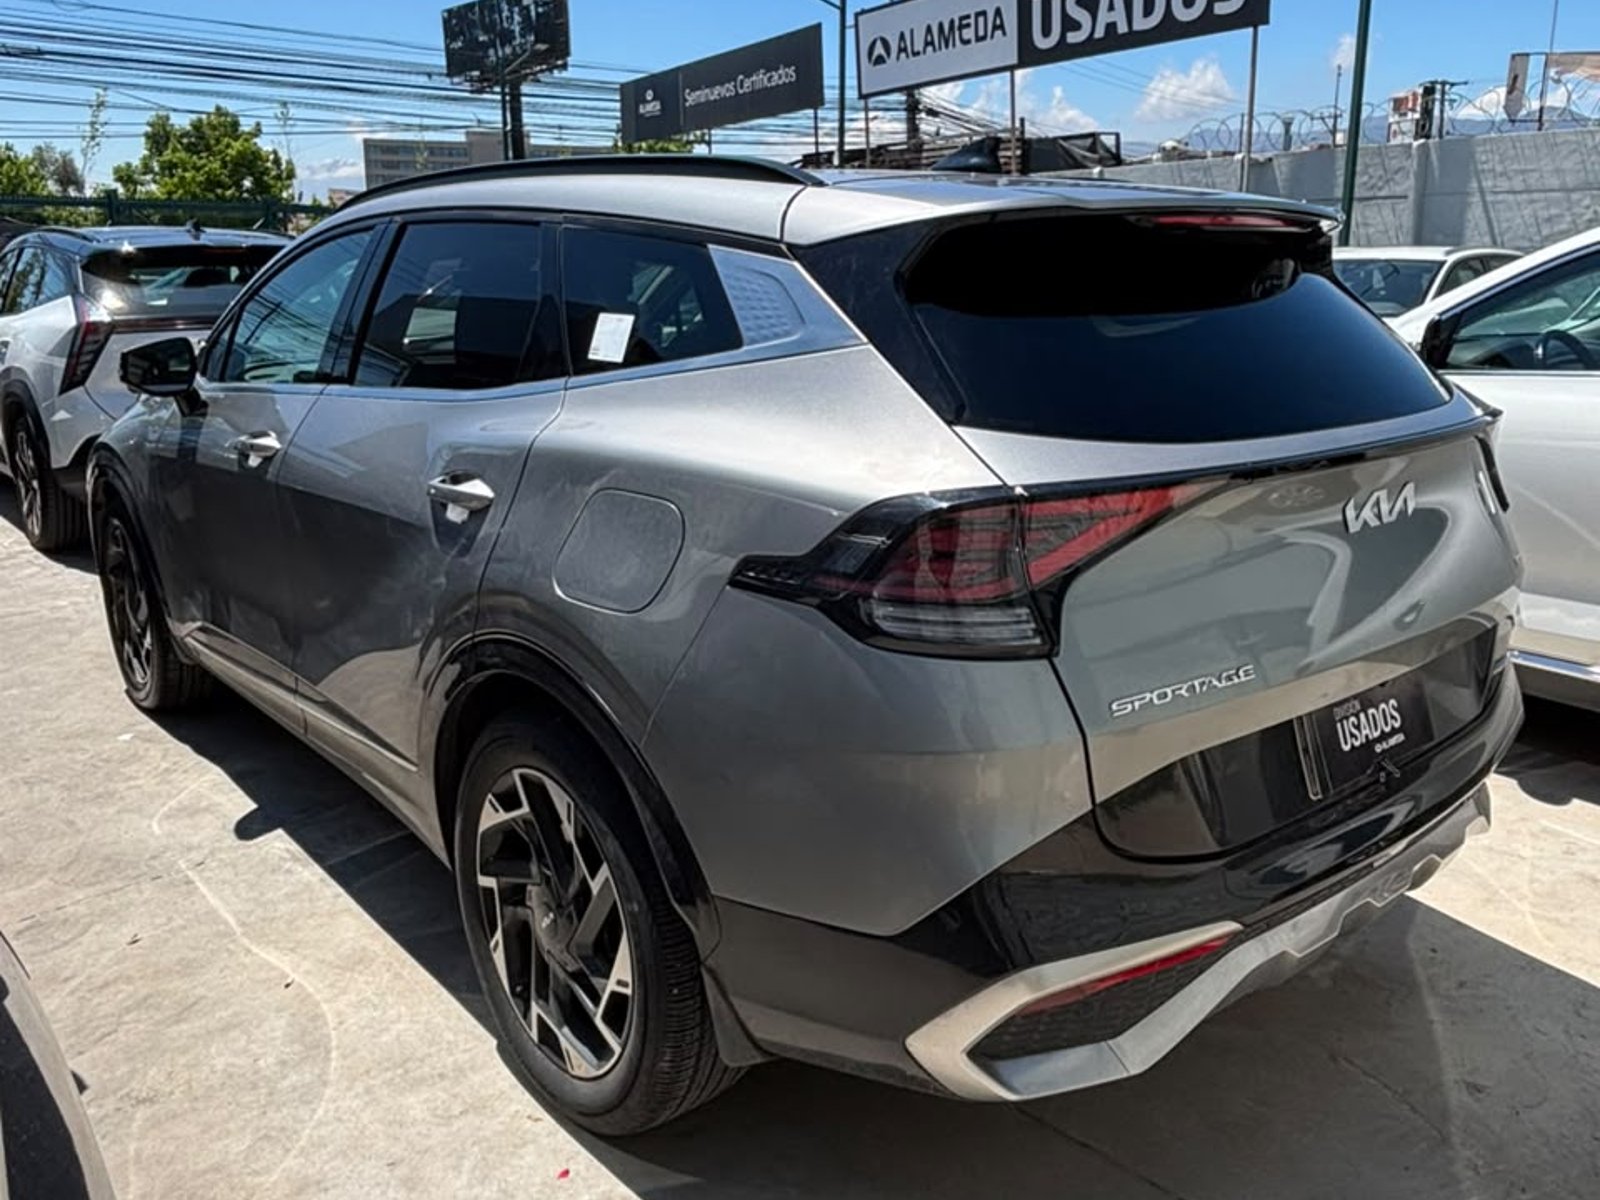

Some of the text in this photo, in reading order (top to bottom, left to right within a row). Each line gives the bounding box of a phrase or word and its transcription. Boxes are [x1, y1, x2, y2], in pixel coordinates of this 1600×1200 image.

[896, 6, 1007, 62] ALAMEDA
[1031, 0, 1246, 50] USAD
[684, 64, 797, 107] Seminuevos Certificados
[1343, 481, 1416, 534] KIA
[1110, 665, 1257, 718] SPORTAGE
[1336, 698, 1402, 752] USADOS
